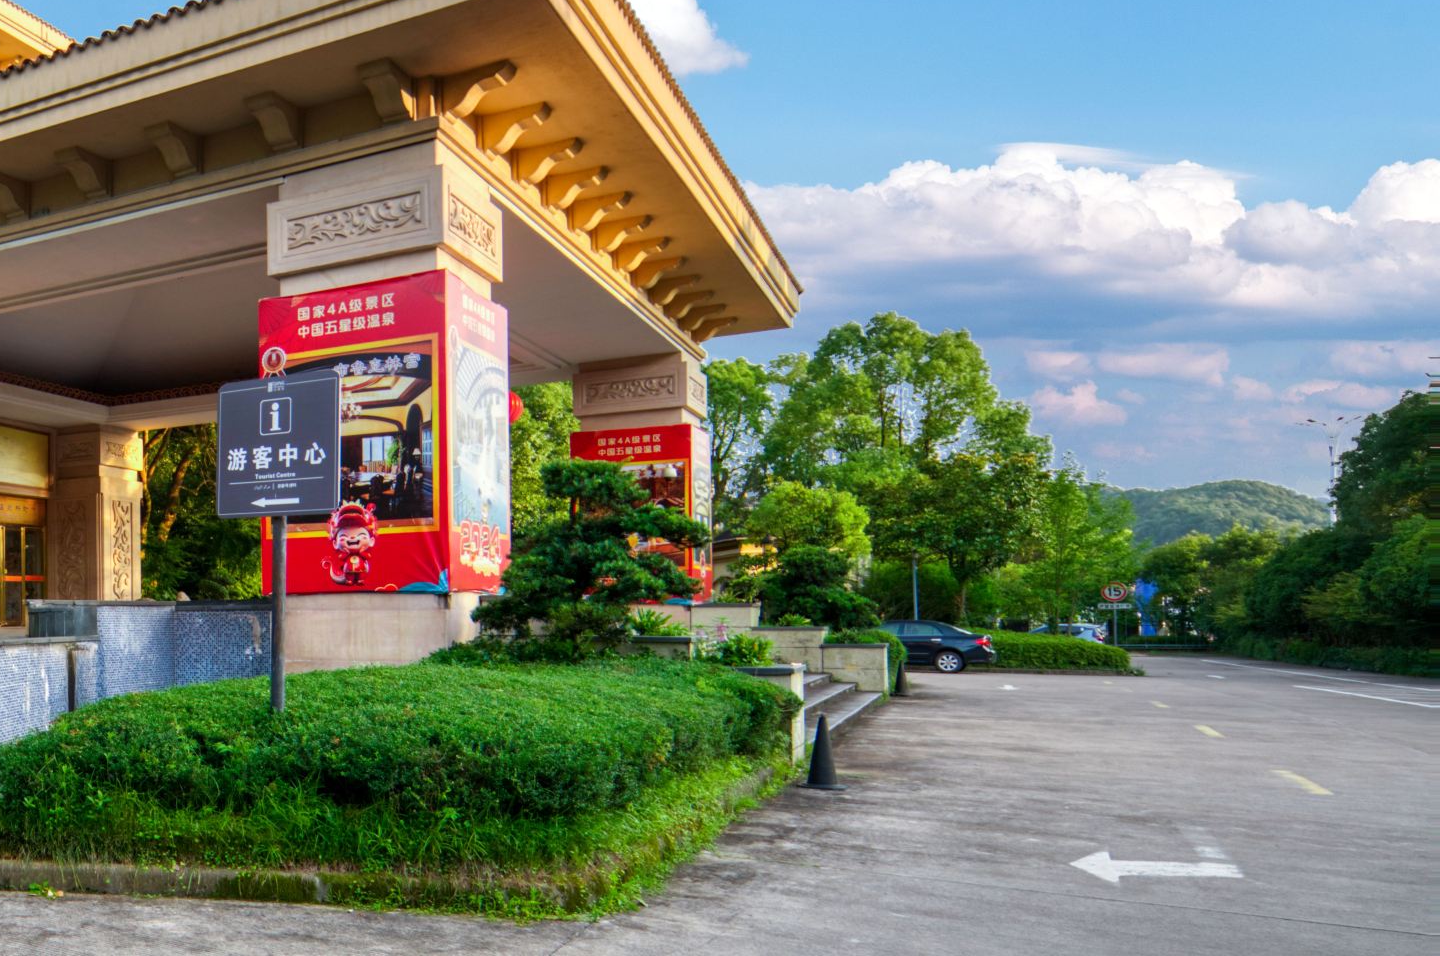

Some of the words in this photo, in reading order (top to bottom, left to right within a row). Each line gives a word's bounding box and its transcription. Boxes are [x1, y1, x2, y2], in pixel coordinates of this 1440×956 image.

[297, 292, 395, 322] 国家4A级景区
[297, 312, 395, 338] 中国五星级温泉
[227, 442, 326, 471] 游客中心
[1108, 587, 1122, 597] 15
